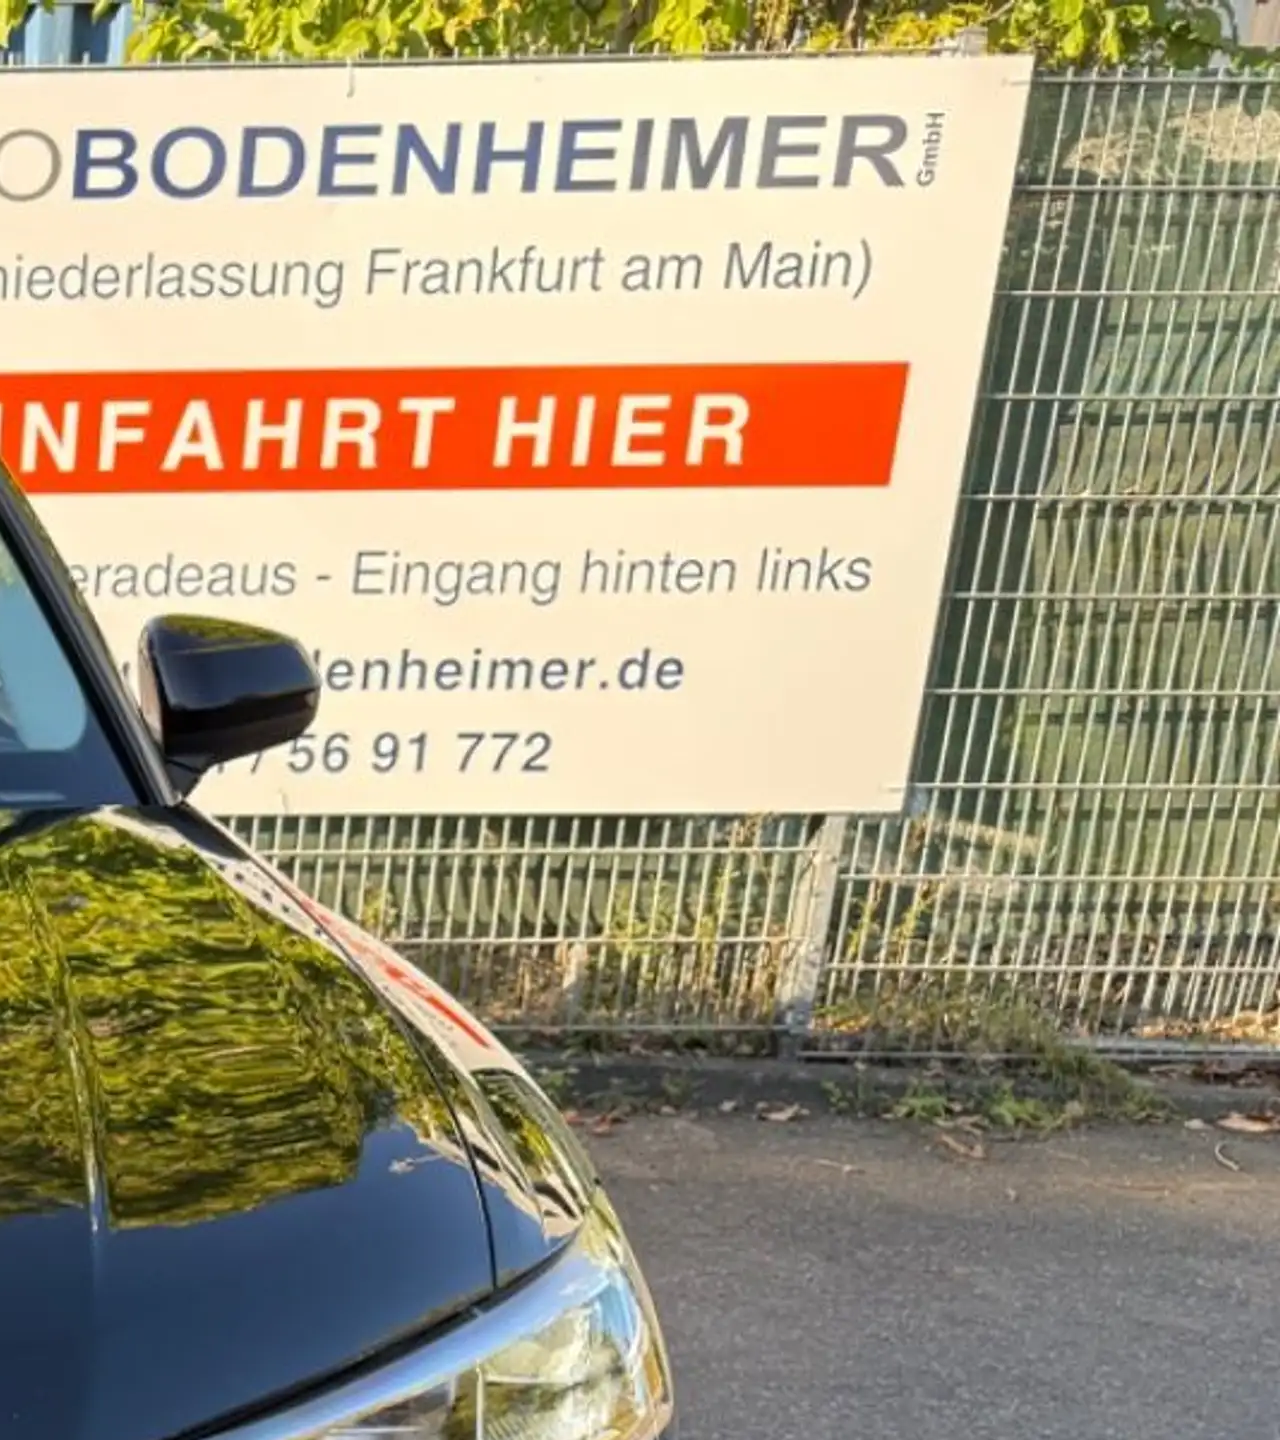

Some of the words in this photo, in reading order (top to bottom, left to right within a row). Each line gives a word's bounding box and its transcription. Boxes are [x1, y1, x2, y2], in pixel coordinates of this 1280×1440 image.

[915, 112, 946, 188] GmbH
[365, 244, 605, 296] Frankfurt
[620, 253, 703, 292] am
[723, 238, 873, 301] Main)
[492, 393, 750, 469] HIER
[67, 552, 297, 598] eradeaus
[351, 550, 562, 607] Eingang
[580, 547, 737, 594] hinten
[755, 546, 874, 592] links
[312, 647, 685, 692] enheimer.de
[287, 731, 351, 774] 56
[371, 731, 429, 774] 91
[456, 731, 553, 773] 772
